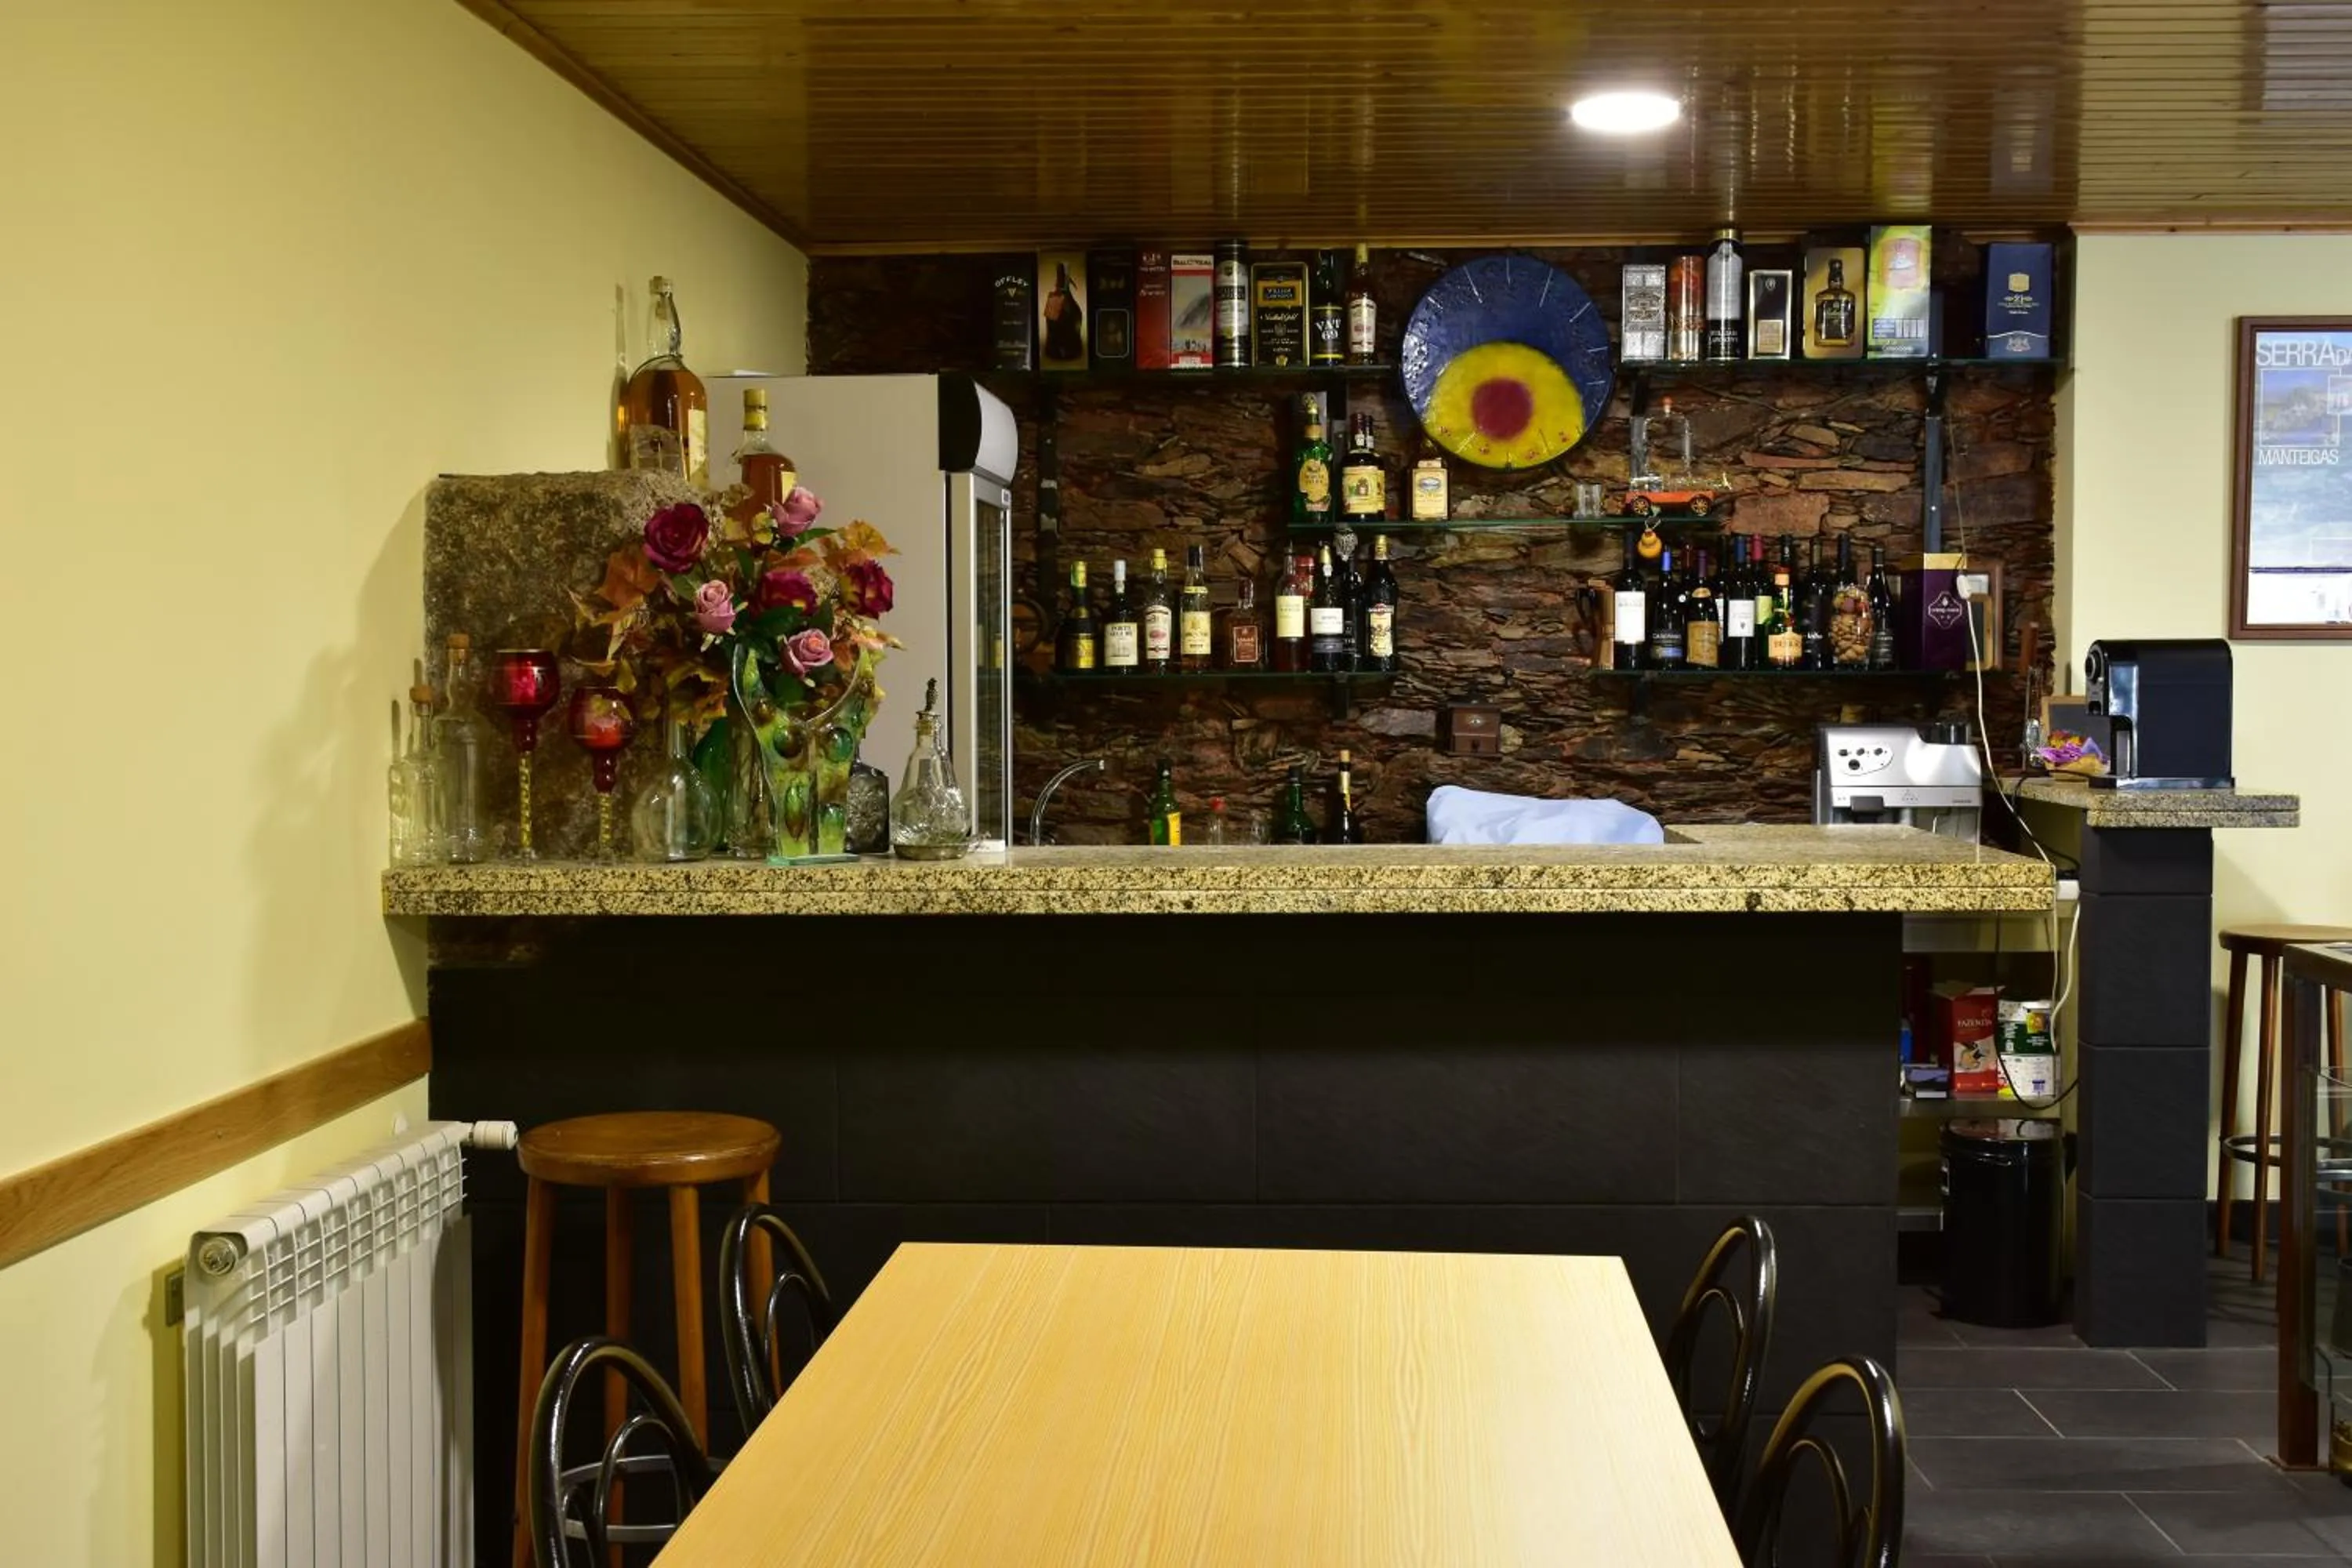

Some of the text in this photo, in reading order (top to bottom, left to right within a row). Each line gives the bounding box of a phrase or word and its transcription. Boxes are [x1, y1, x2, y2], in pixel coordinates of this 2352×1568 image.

[994, 276, 1029, 288] OFFLEY
[1315, 318, 1341, 331] VAT
[1321, 328, 1338, 340] 69
[2256, 339, 2336, 366] SERRA
[2259, 448, 2339, 465] MANTEIGAS
